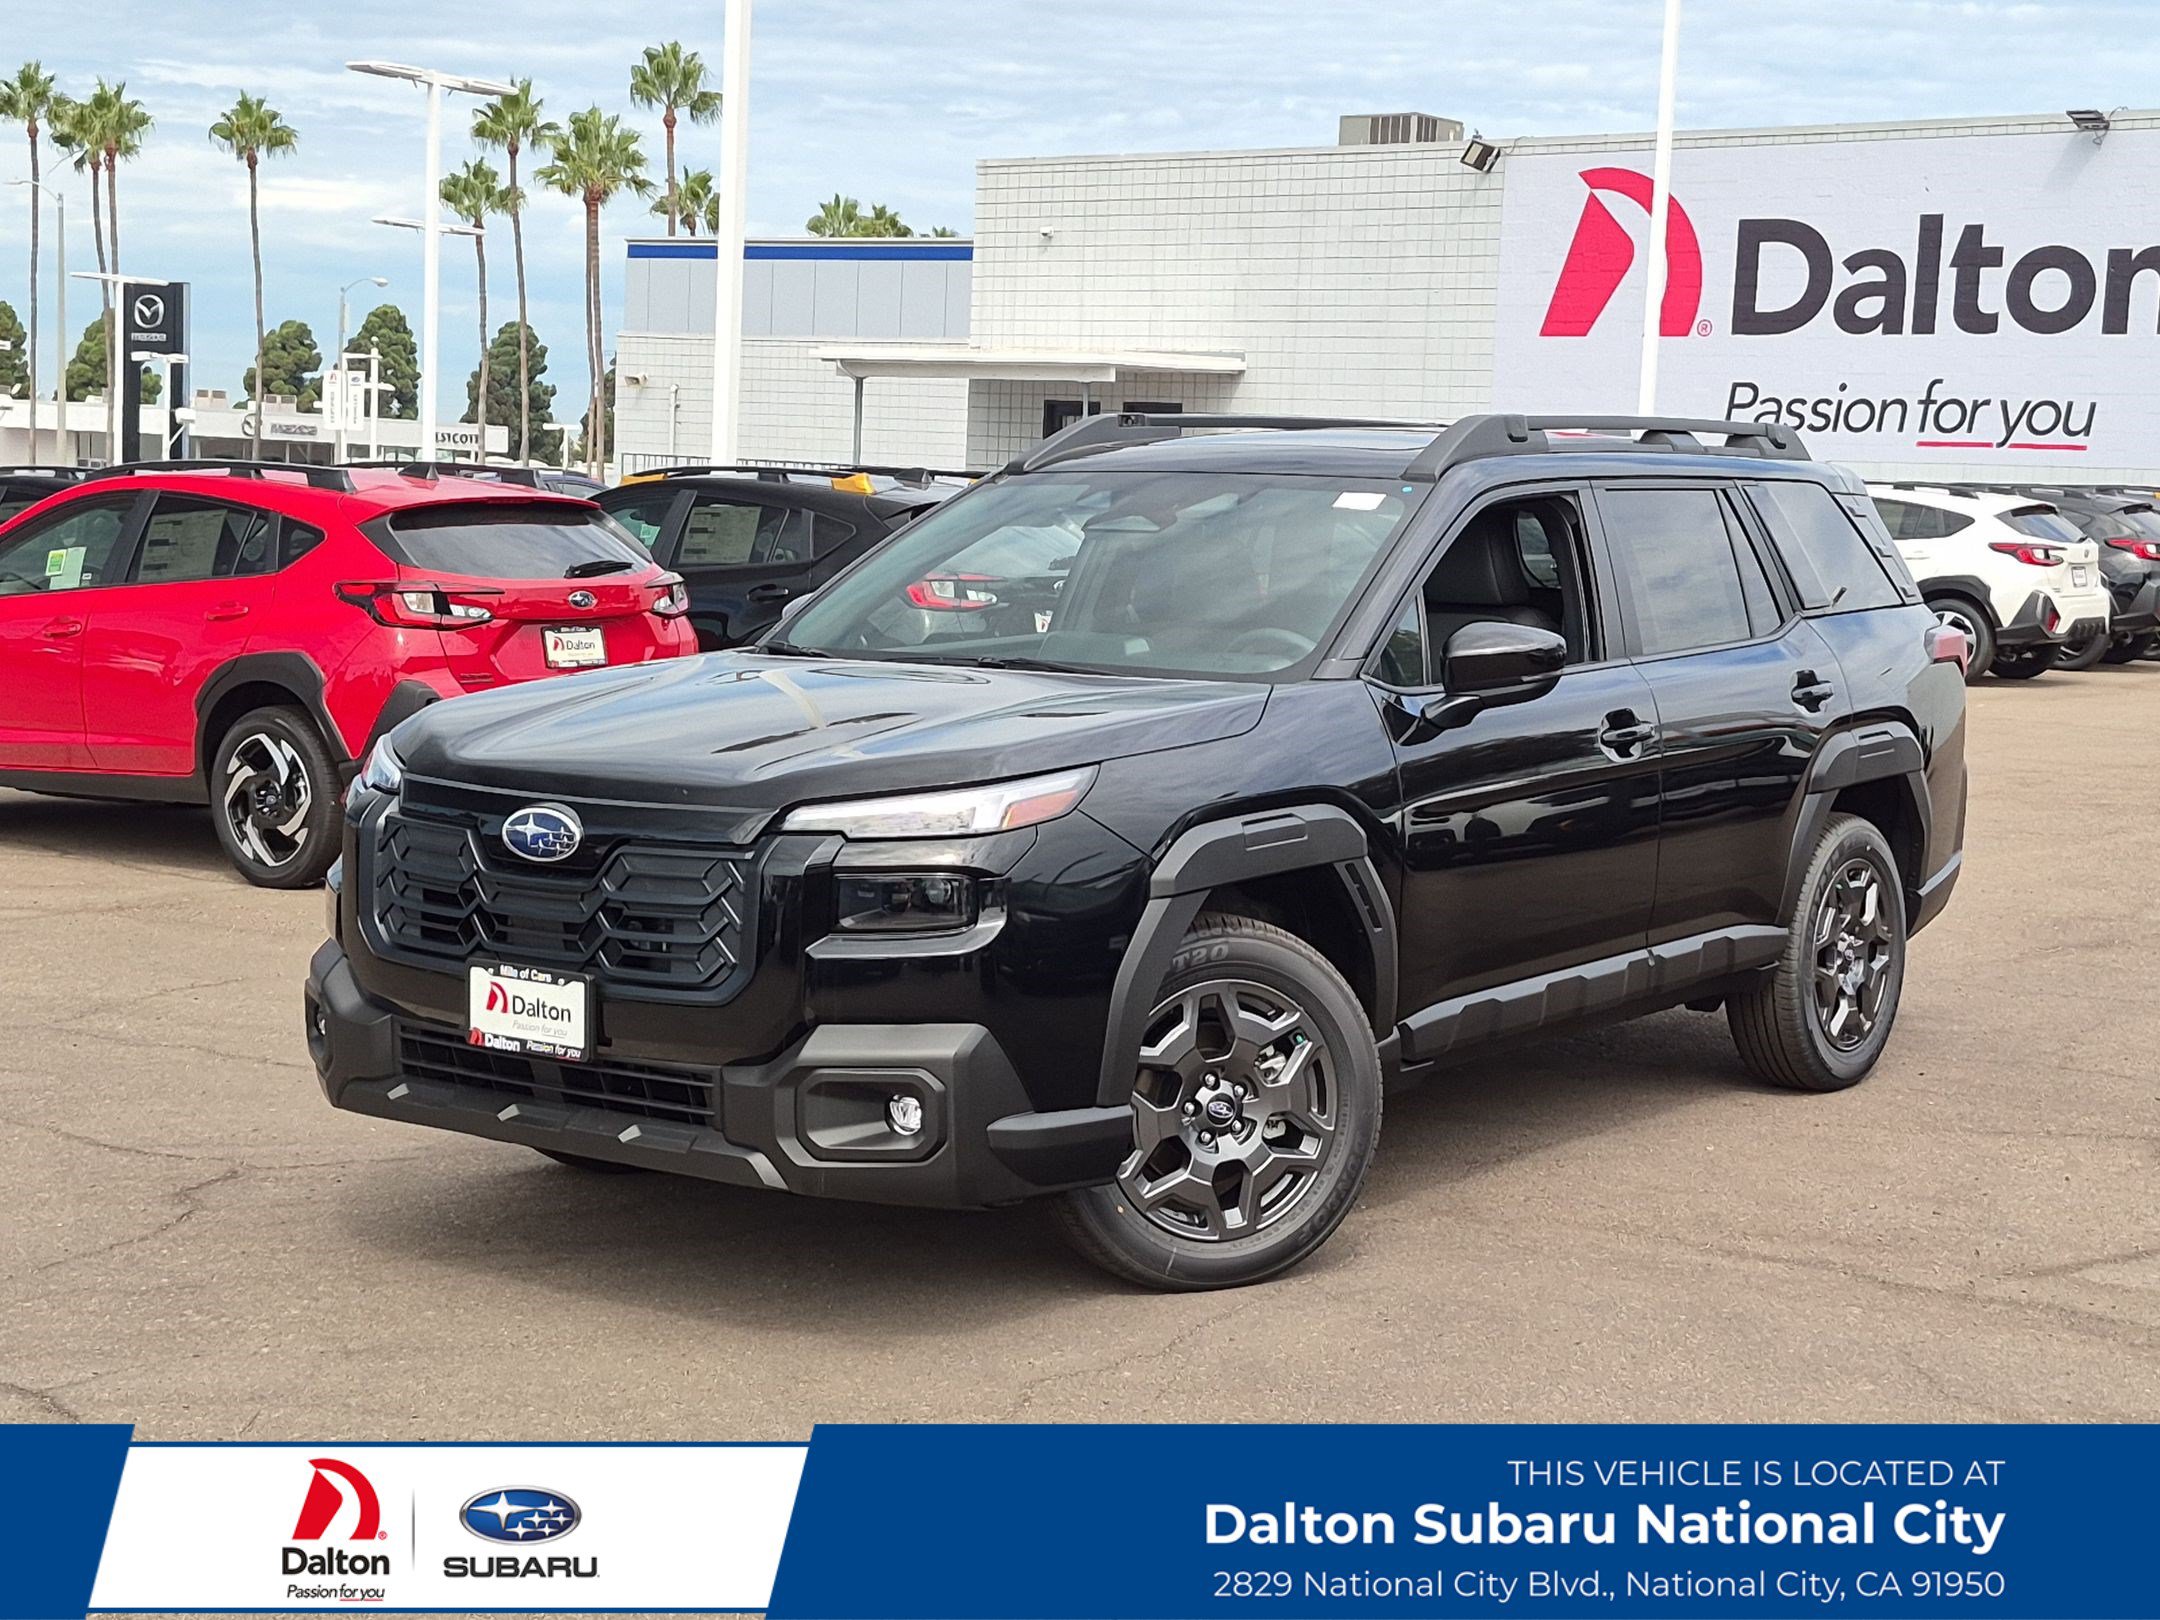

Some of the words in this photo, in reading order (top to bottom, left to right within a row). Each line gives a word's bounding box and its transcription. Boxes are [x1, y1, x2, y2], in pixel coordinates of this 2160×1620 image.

[1731, 213, 2160, 335] Dalton
[1724, 381, 1909, 433] Passion
[1917, 378, 1992, 434] for
[1995, 399, 2097, 449] you
[566, 639, 596, 651] Dalton
[512, 994, 572, 1023] Dalton
[484, 1033, 521, 1052] Dalton
